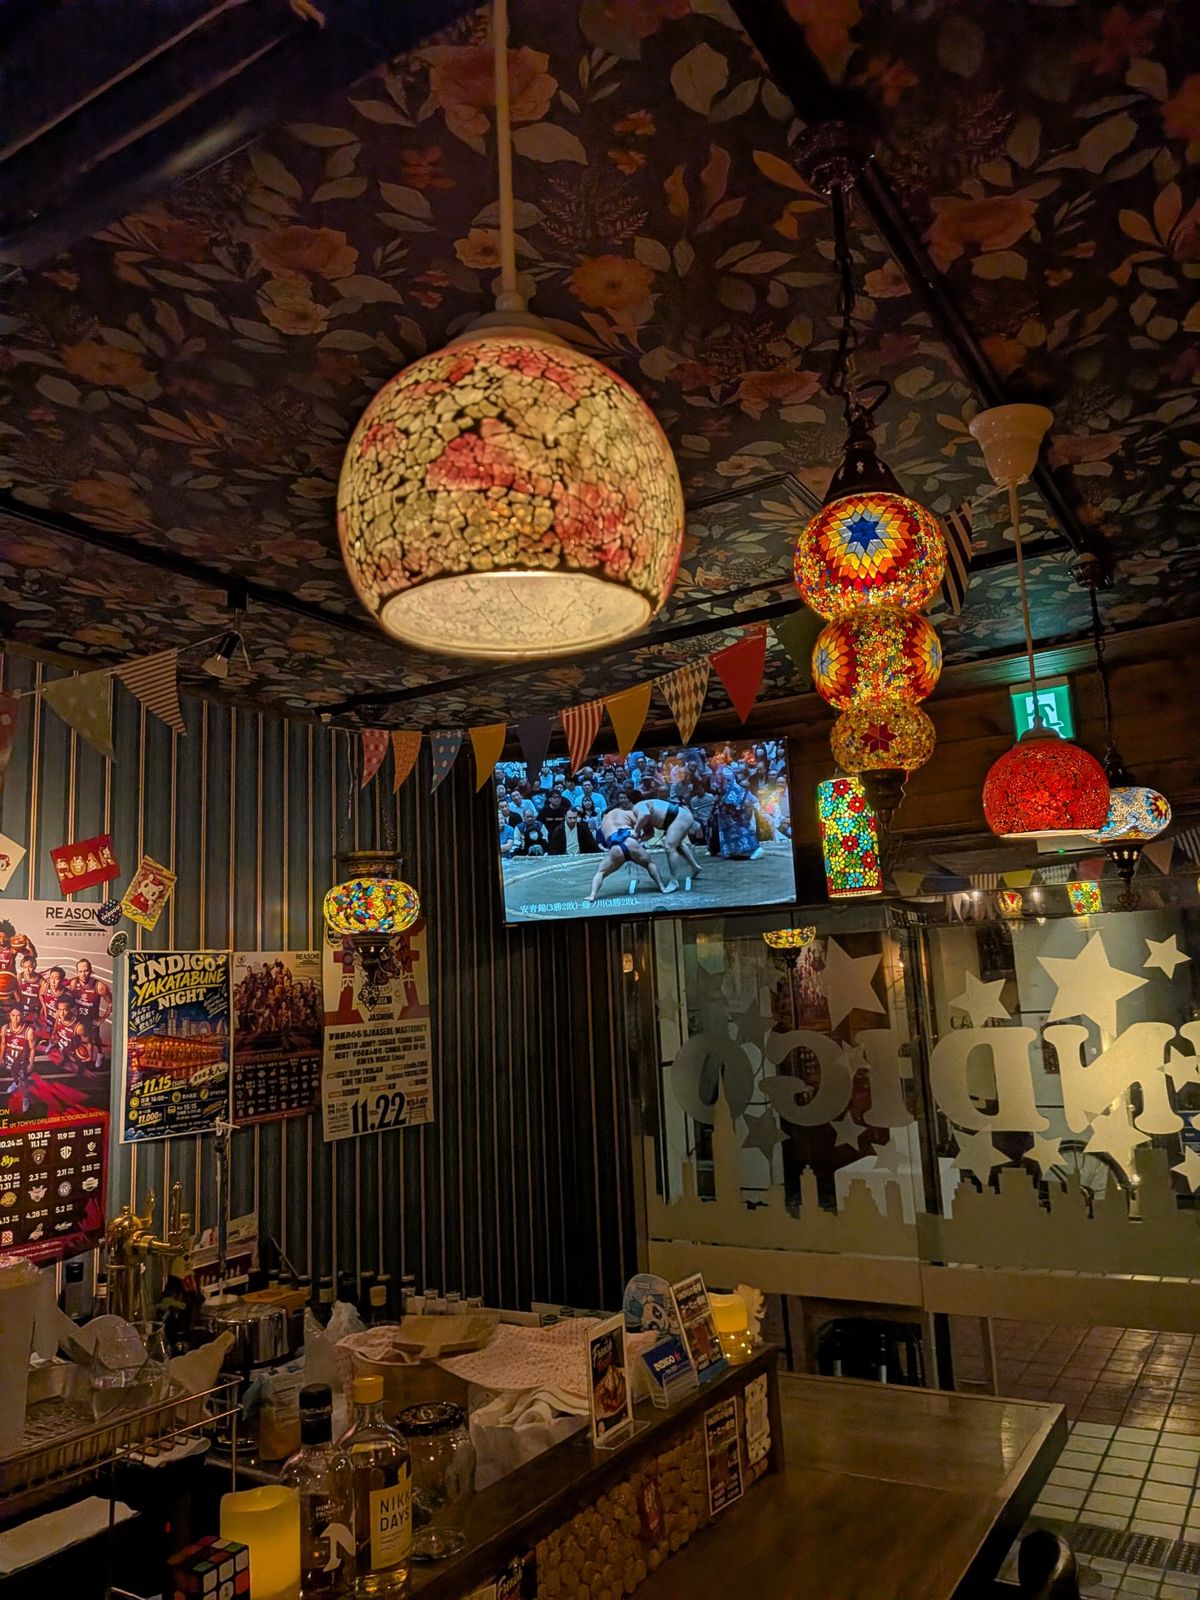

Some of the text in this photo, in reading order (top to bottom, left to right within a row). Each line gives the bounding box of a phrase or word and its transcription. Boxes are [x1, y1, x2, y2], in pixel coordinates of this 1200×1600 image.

[135, 954, 217, 985] INDIGO
[133, 968, 226, 1006] YAKATABUNE
[157, 988, 207, 1010] NIGHT
[144, 1074, 172, 1094] 11.15
[350, 1091, 407, 1134] 11.22
[28, 1132, 43, 1140] 10.31
[57, 1132, 68, 1140] 11.9
[56, 1169, 67, 1177] 2.11
[81, 1164, 93, 1173] 2.15
[29, 1174, 39, 1182] 2.3
[25, 1211, 40, 1219] 4.28
[55, 1206, 66, 1214] 5.2
[652, 1354, 675, 1372] INDIGO
[380, 1507, 410, 1532] DAYS
